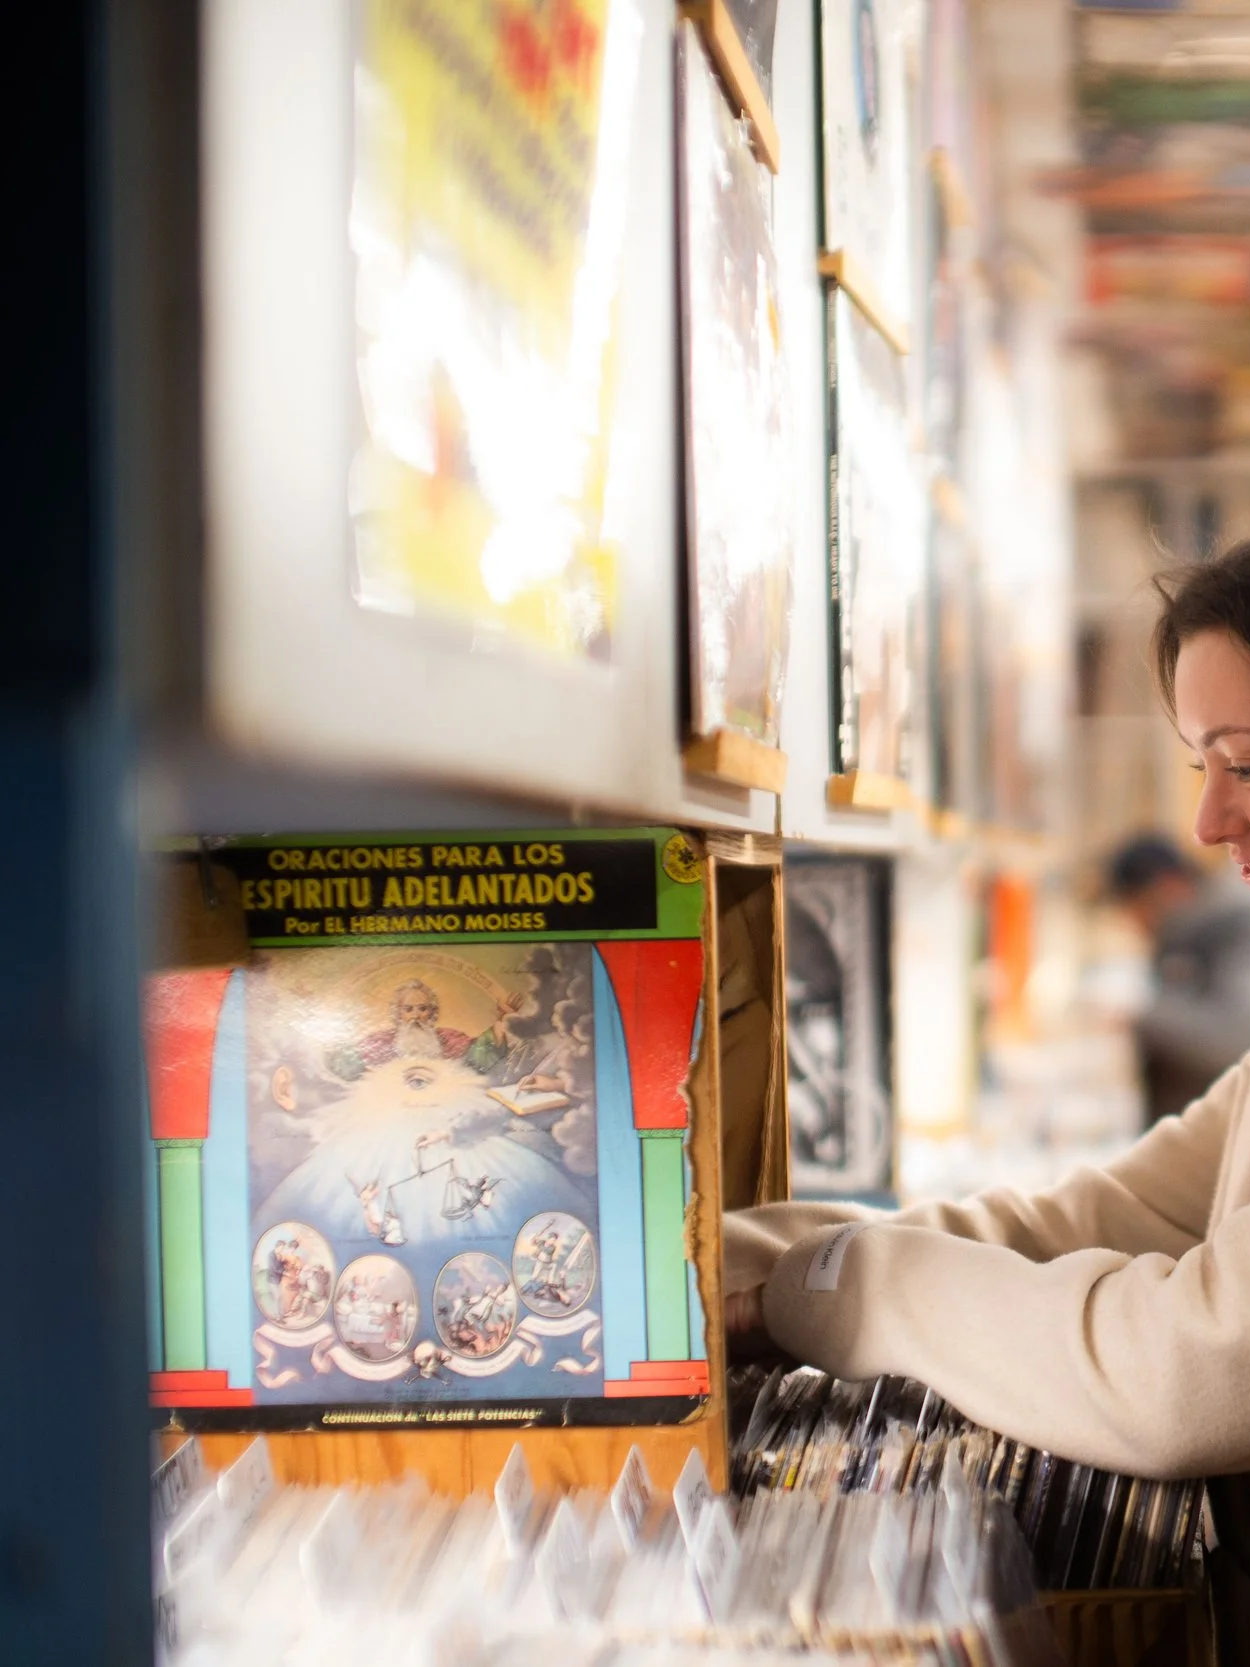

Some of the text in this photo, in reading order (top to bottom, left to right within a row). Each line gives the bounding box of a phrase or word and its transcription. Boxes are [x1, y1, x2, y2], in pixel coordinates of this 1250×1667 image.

[268, 843, 565, 871] ORACIONES PARA LOS
[241, 871, 595, 909] ESPIRITU ADELANTADOS
[285, 912, 546, 934] Por EL HERMANO MOISES
[322, 1412, 402, 1424] CONTINUACION
[446, 1410, 475, 1421] SIETE
